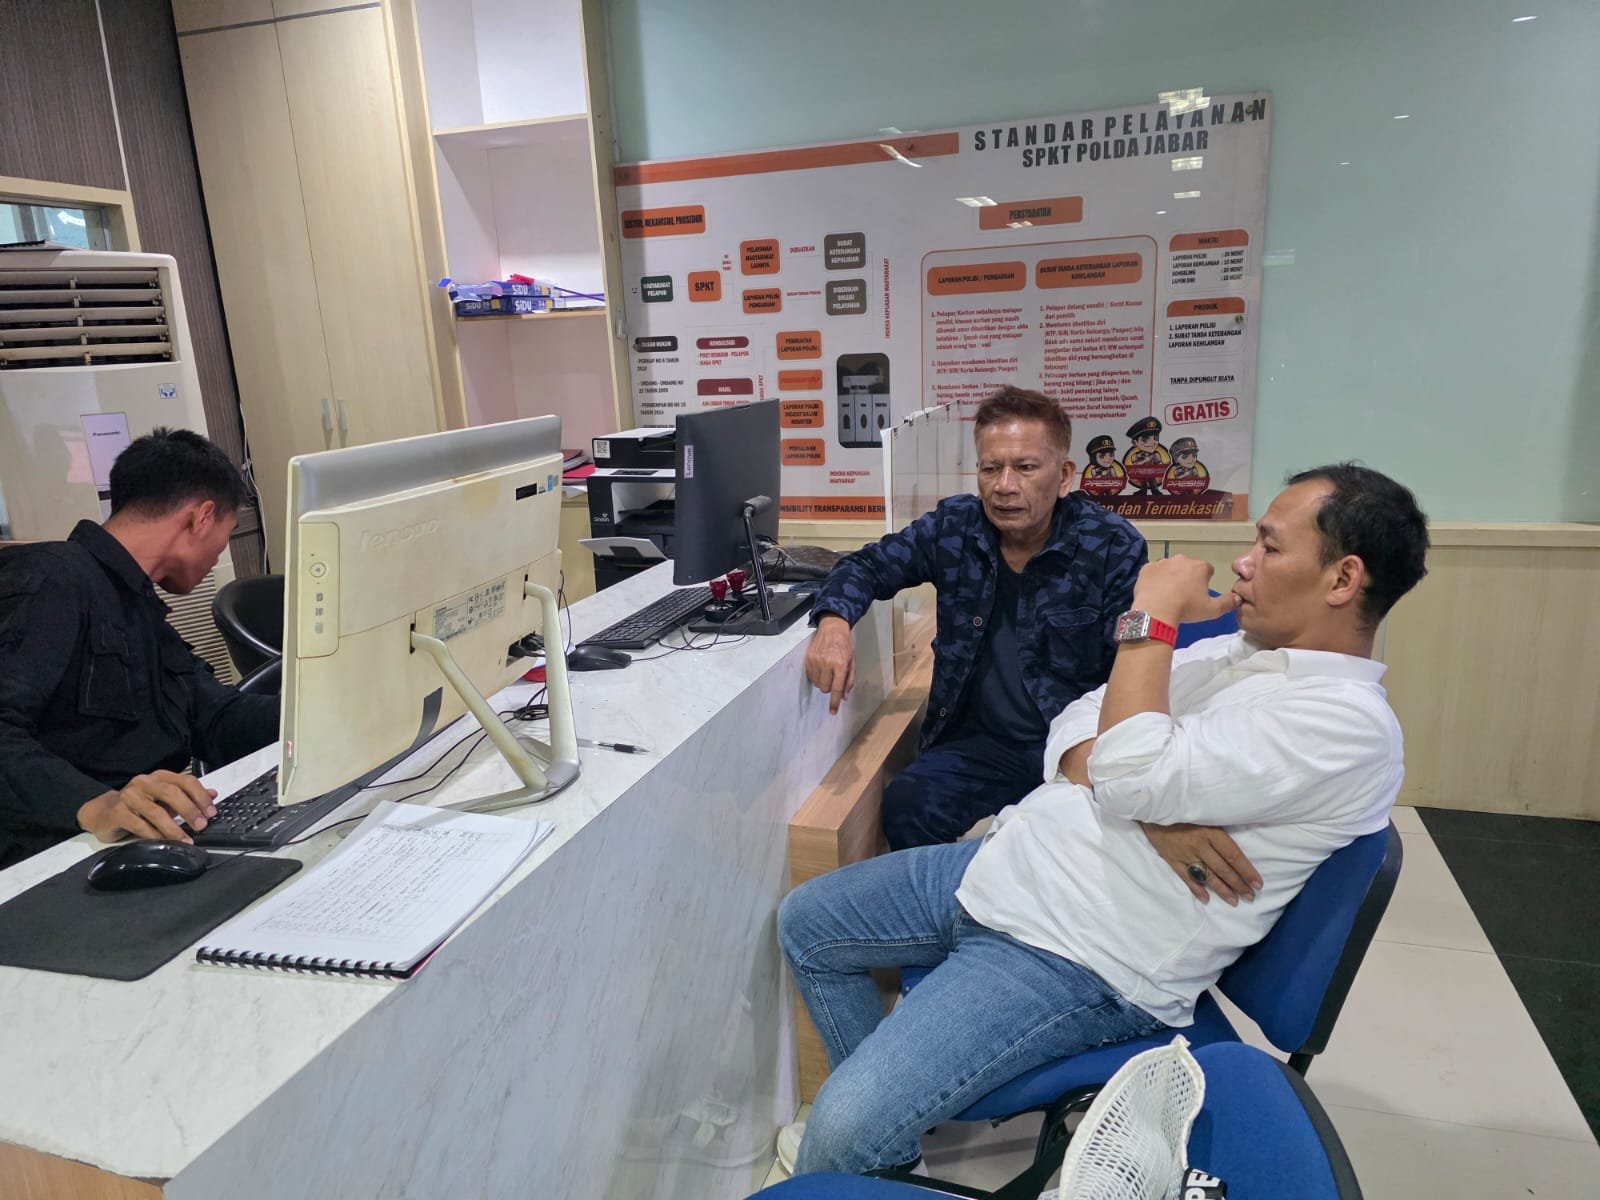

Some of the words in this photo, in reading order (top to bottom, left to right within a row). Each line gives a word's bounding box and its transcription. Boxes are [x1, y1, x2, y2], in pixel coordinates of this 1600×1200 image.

[975, 119, 1094, 151] STANDAR
[1105, 99, 1266, 137] PELAYANAN
[1023, 145, 1072, 168] SPKT
[1077, 137, 1139, 162] POLDA
[1145, 130, 1209, 155] JABAR
[695, 281, 715, 292] SPKT
[1172, 401, 1230, 422] GRATIS
[1117, 502, 1141, 515] dan
[1145, 500, 1224, 515] Terimakasih
